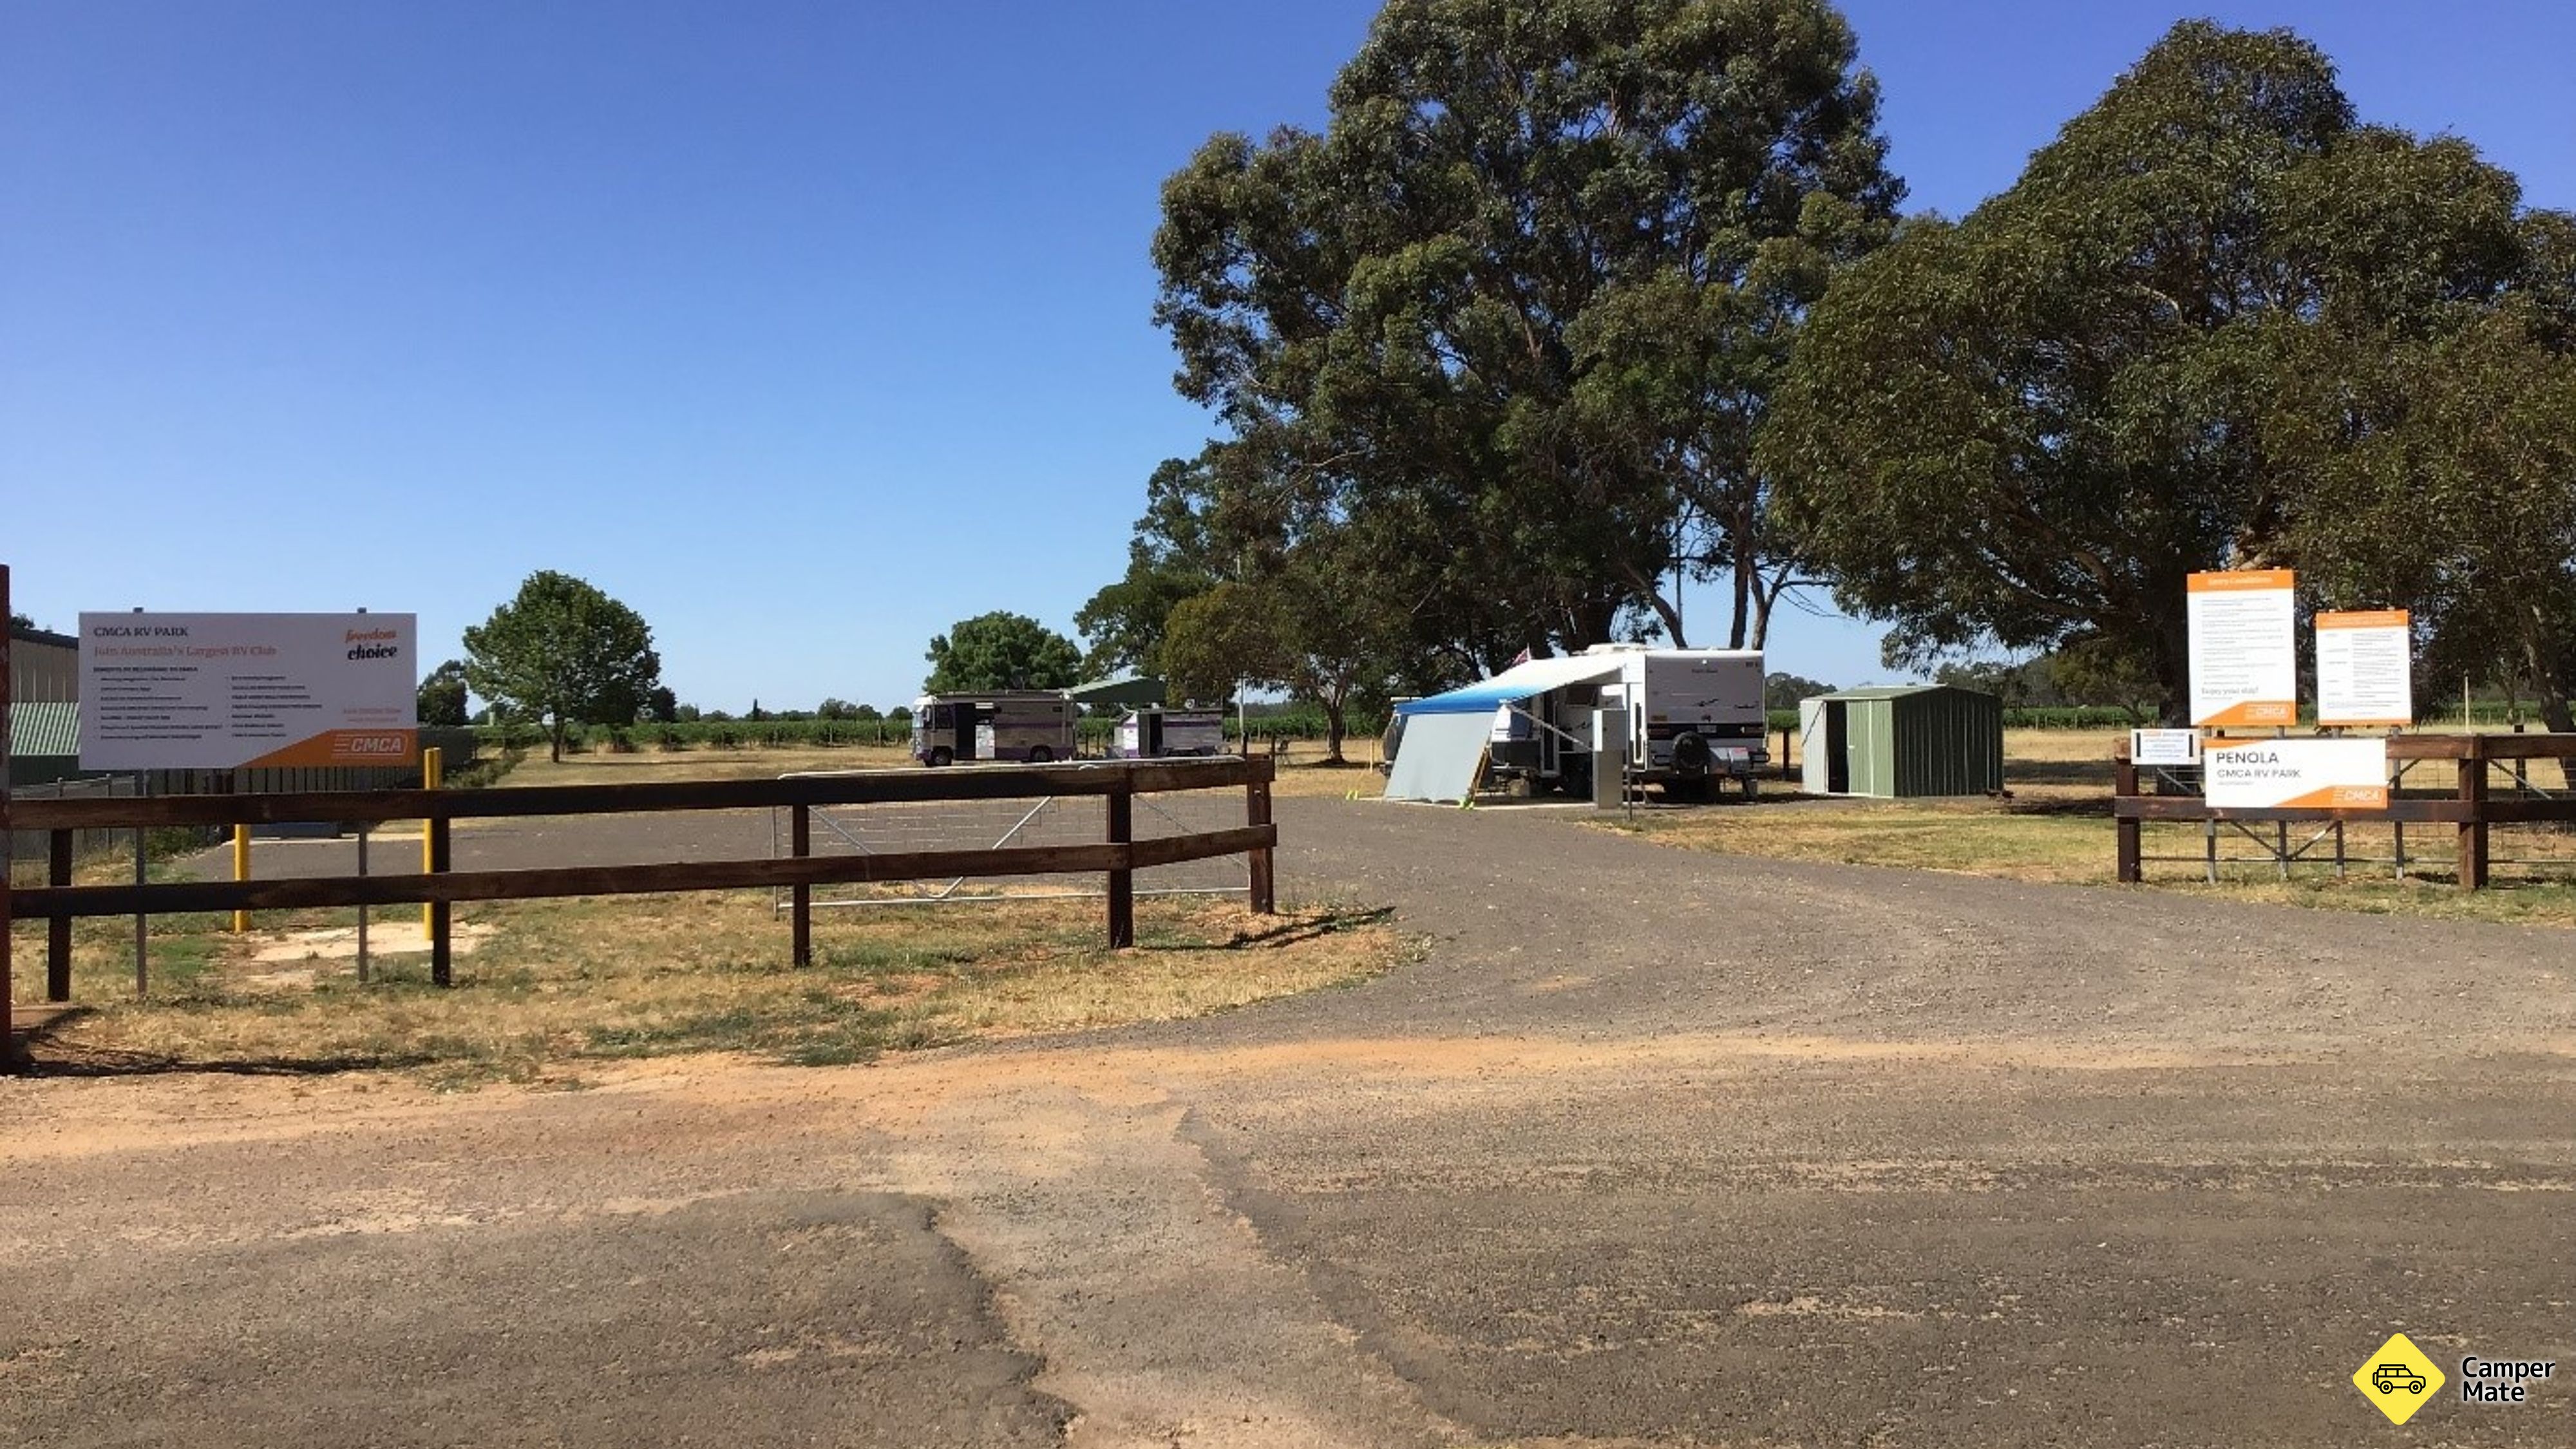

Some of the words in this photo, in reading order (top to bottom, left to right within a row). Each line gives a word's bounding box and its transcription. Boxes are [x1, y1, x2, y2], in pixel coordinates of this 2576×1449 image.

[93, 627, 131, 636] CMCA
[134, 627, 151, 636] RV
[155, 627, 189, 636] PARK
[187, 647, 229, 658] Largest
[231, 647, 247, 655] RV
[250, 646, 277, 655] Club
[347, 643, 397, 660] choice
[351, 737, 401, 752] CMCA
[2216, 752, 2279, 763] PENOLA
[2217, 769, 2251, 778] CMCA
[2254, 769, 2269, 778] RV
[2272, 769, 2301, 778] PARK
